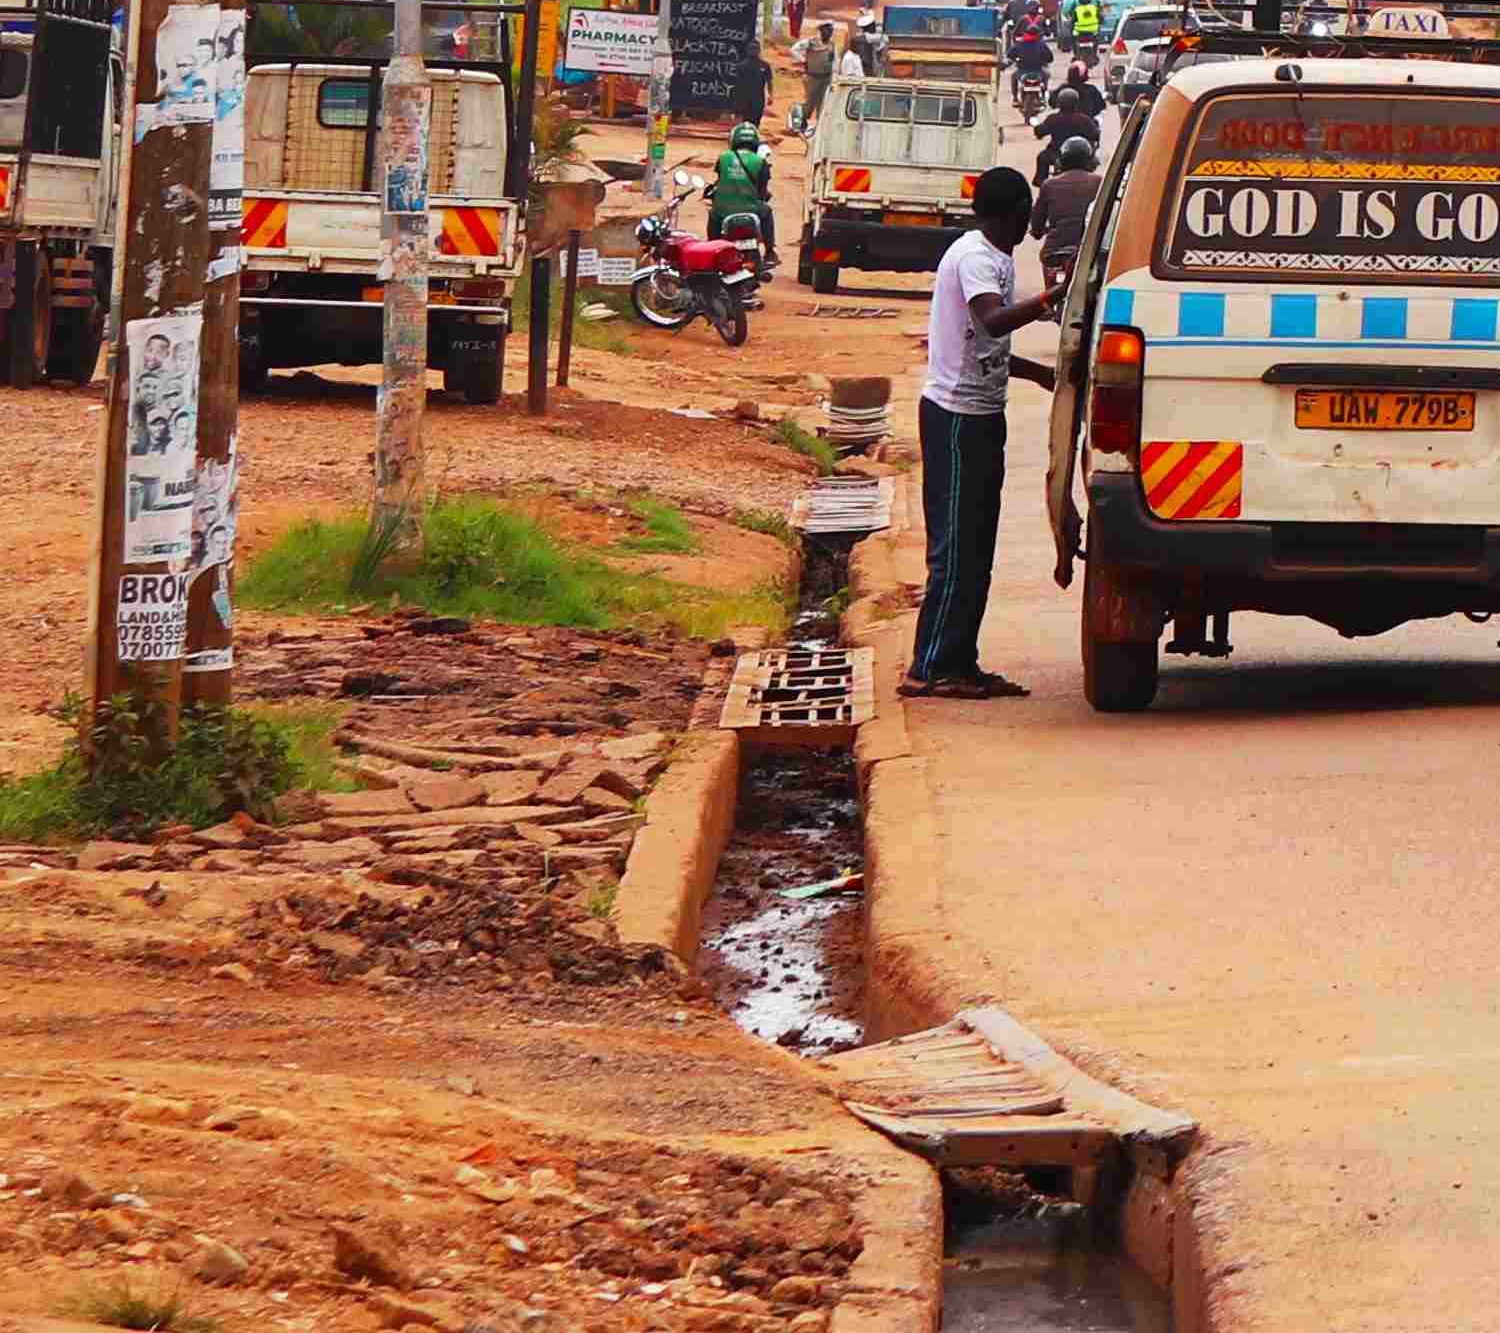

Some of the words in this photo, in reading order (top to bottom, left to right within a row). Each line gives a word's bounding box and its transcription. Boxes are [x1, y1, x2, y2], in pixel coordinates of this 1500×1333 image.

[1382, 11, 1439, 33] TAXI
[571, 29, 657, 45] PHARMACY
[1185, 187, 1318, 238] GOD
[1336, 190, 1396, 238] IS
[1329, 396, 1382, 424] UAW
[1394, 395, 1459, 423] 779B
